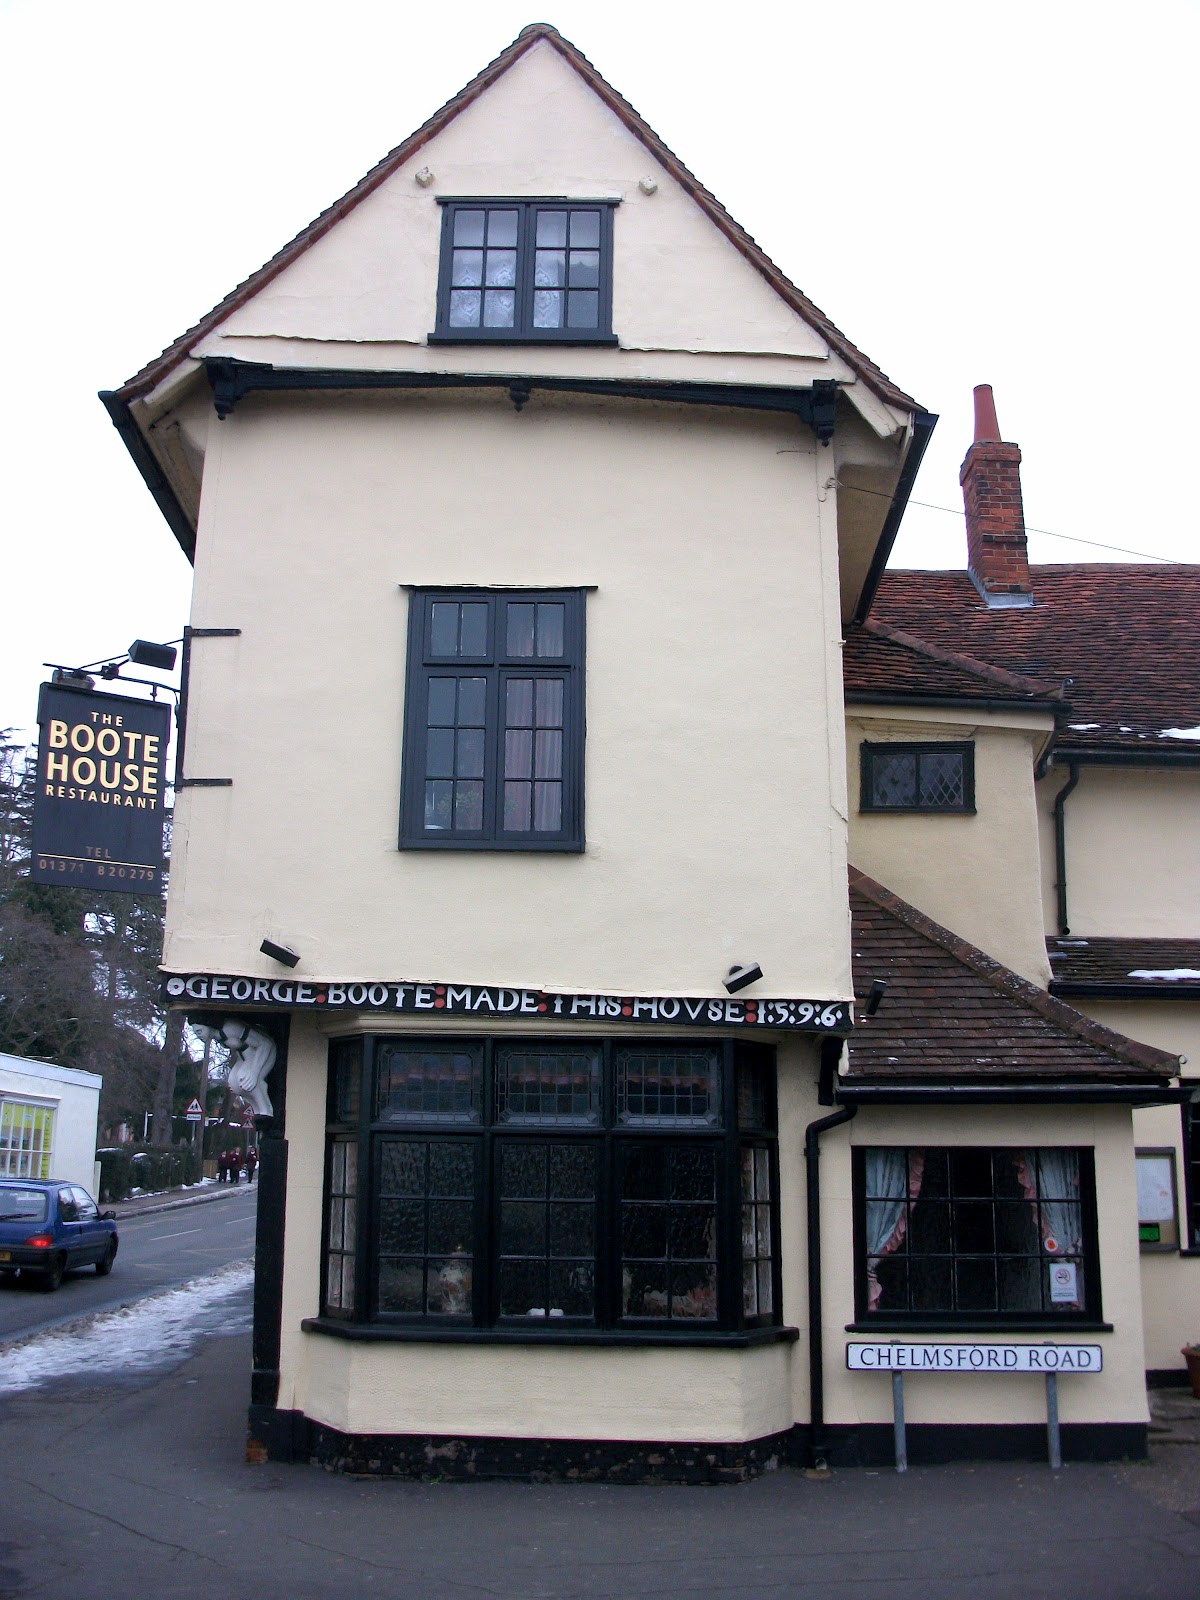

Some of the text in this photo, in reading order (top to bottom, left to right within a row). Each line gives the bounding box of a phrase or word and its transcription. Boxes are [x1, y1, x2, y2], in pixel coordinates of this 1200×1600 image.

[91, 711, 124, 727] THE
[49, 719, 160, 764] BOOTE
[47, 751, 159, 795] HOUSE
[45, 784, 158, 810] RESTAURANT
[86, 846, 112, 859] TEL
[39, 859, 155, 881] 01371 820279
[185, 974, 317, 1004] GEORGE
[327, 982, 436, 1009] BOOTE
[446, 986, 538, 1013] MADE
[860, 1347, 1092, 1368] CHELMSFORD ROAD
